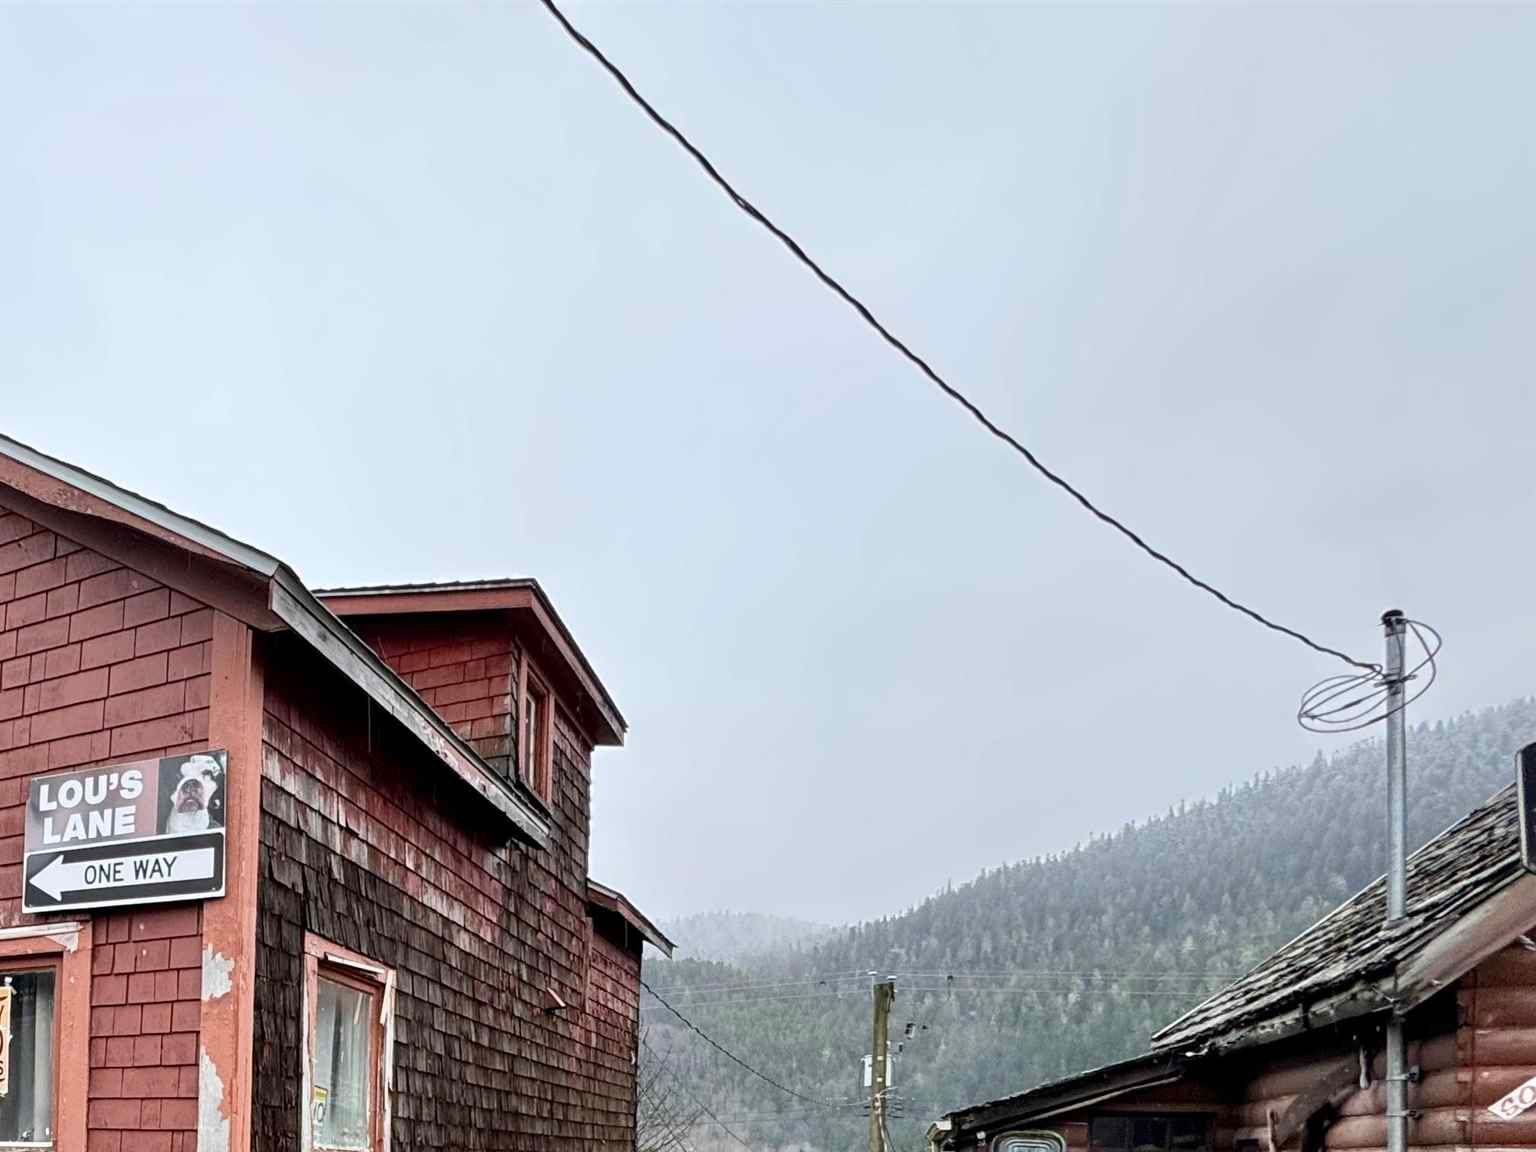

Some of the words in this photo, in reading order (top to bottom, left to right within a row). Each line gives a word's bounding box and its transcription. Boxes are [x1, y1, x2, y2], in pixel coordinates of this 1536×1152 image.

[39, 770, 144, 811] LOU'S
[43, 805, 137, 845] LANE
[84, 862, 125, 885] ONE
[134, 856, 178, 880] WAY
